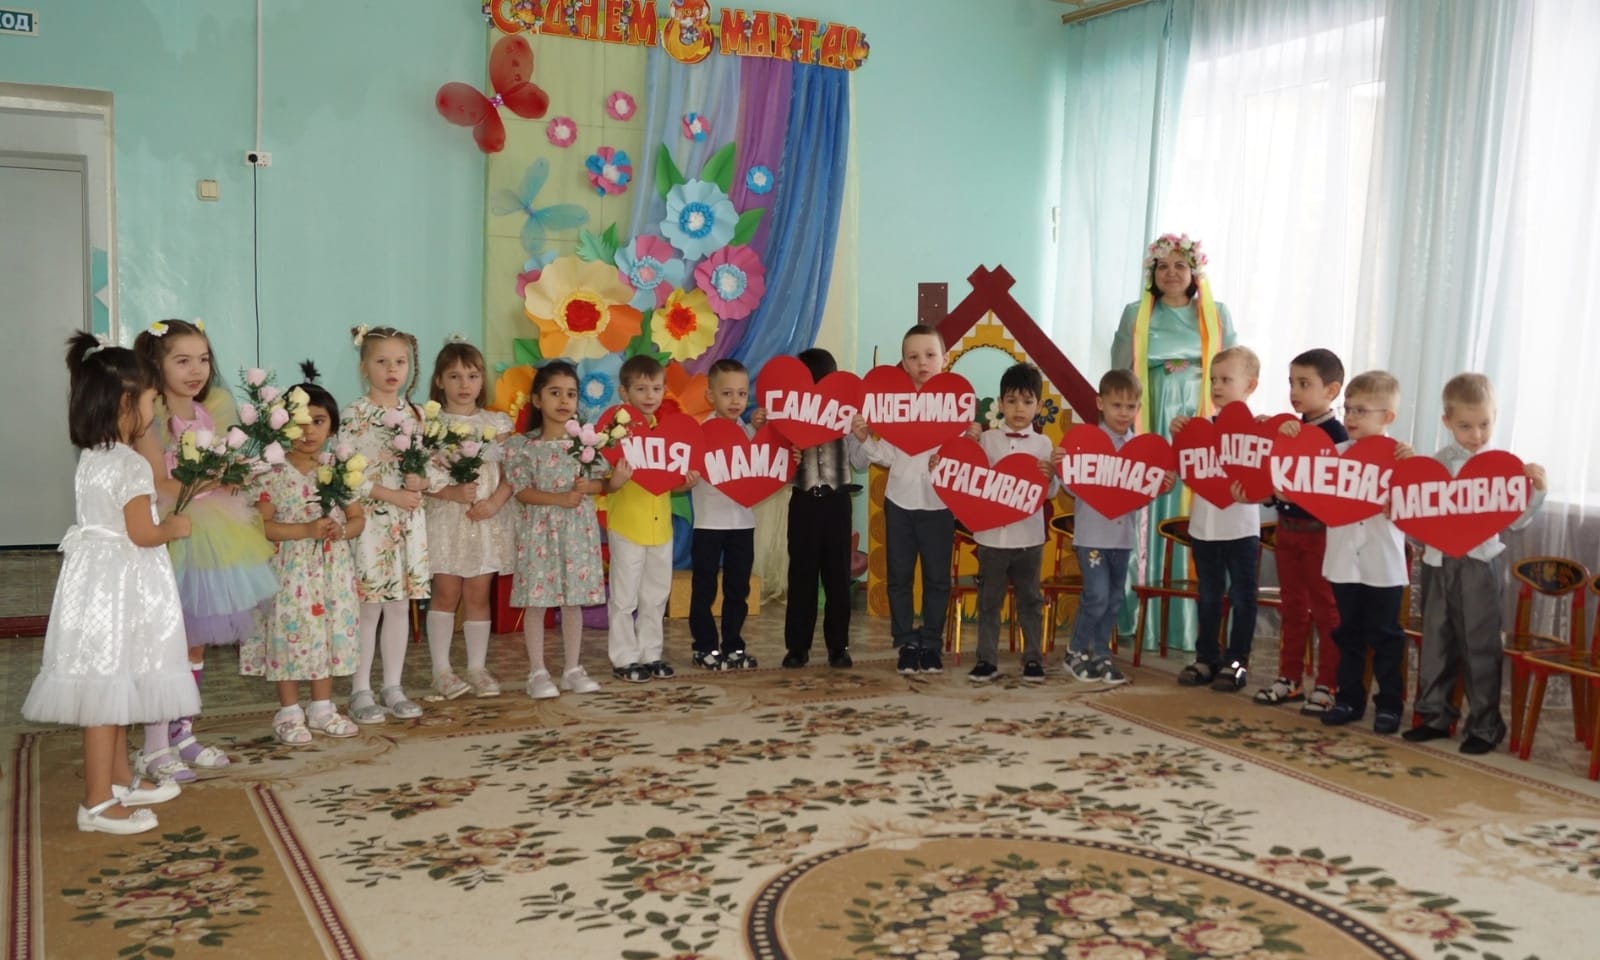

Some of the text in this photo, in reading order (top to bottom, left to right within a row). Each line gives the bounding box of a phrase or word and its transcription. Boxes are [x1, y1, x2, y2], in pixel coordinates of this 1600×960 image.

[0, 12, 30, 31] ОД
[490, 0, 860, 71] С ДНЕМ 8 МАРТА!
[765, 390, 858, 434] САМАЯ
[861, 392, 976, 423] ЛЮБИМАЯ
[620, 436, 691, 476] МОЯ
[704, 443, 789, 486] МАМА
[1219, 433, 1273, 469] ДОБР
[931, 457, 1043, 514] КРАСИВАЯ
[1062, 453, 1165, 498] НЕЖНАЯ
[1390, 475, 1527, 521] ЛАСКОВАЯ
